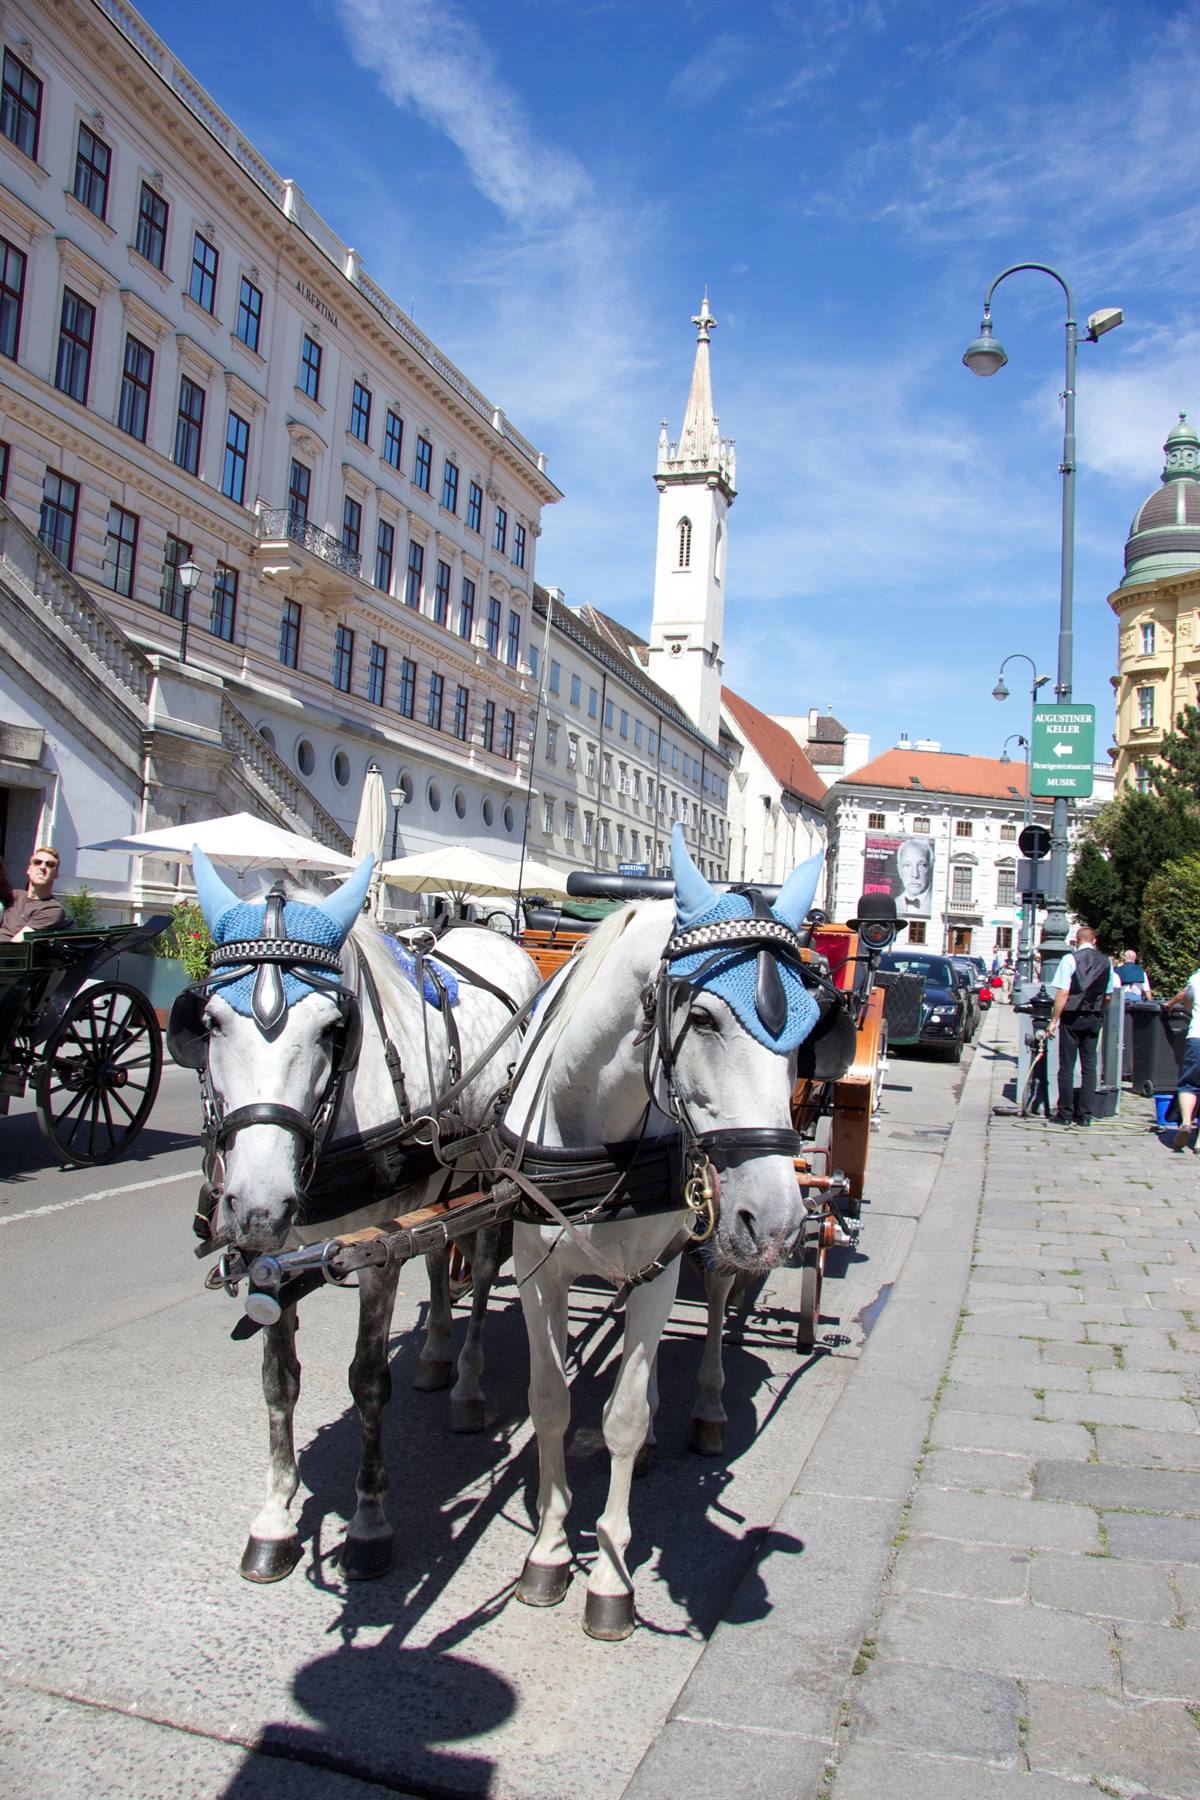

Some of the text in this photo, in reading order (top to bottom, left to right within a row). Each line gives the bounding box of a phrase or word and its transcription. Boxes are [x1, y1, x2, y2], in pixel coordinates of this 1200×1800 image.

[296, 280, 338, 328] ALBERTINA
[1035, 714, 1092, 723] AUGUSTINER
[1046, 725, 1080, 734] KELLER
[1046, 778, 1076, 786] MUSIK
